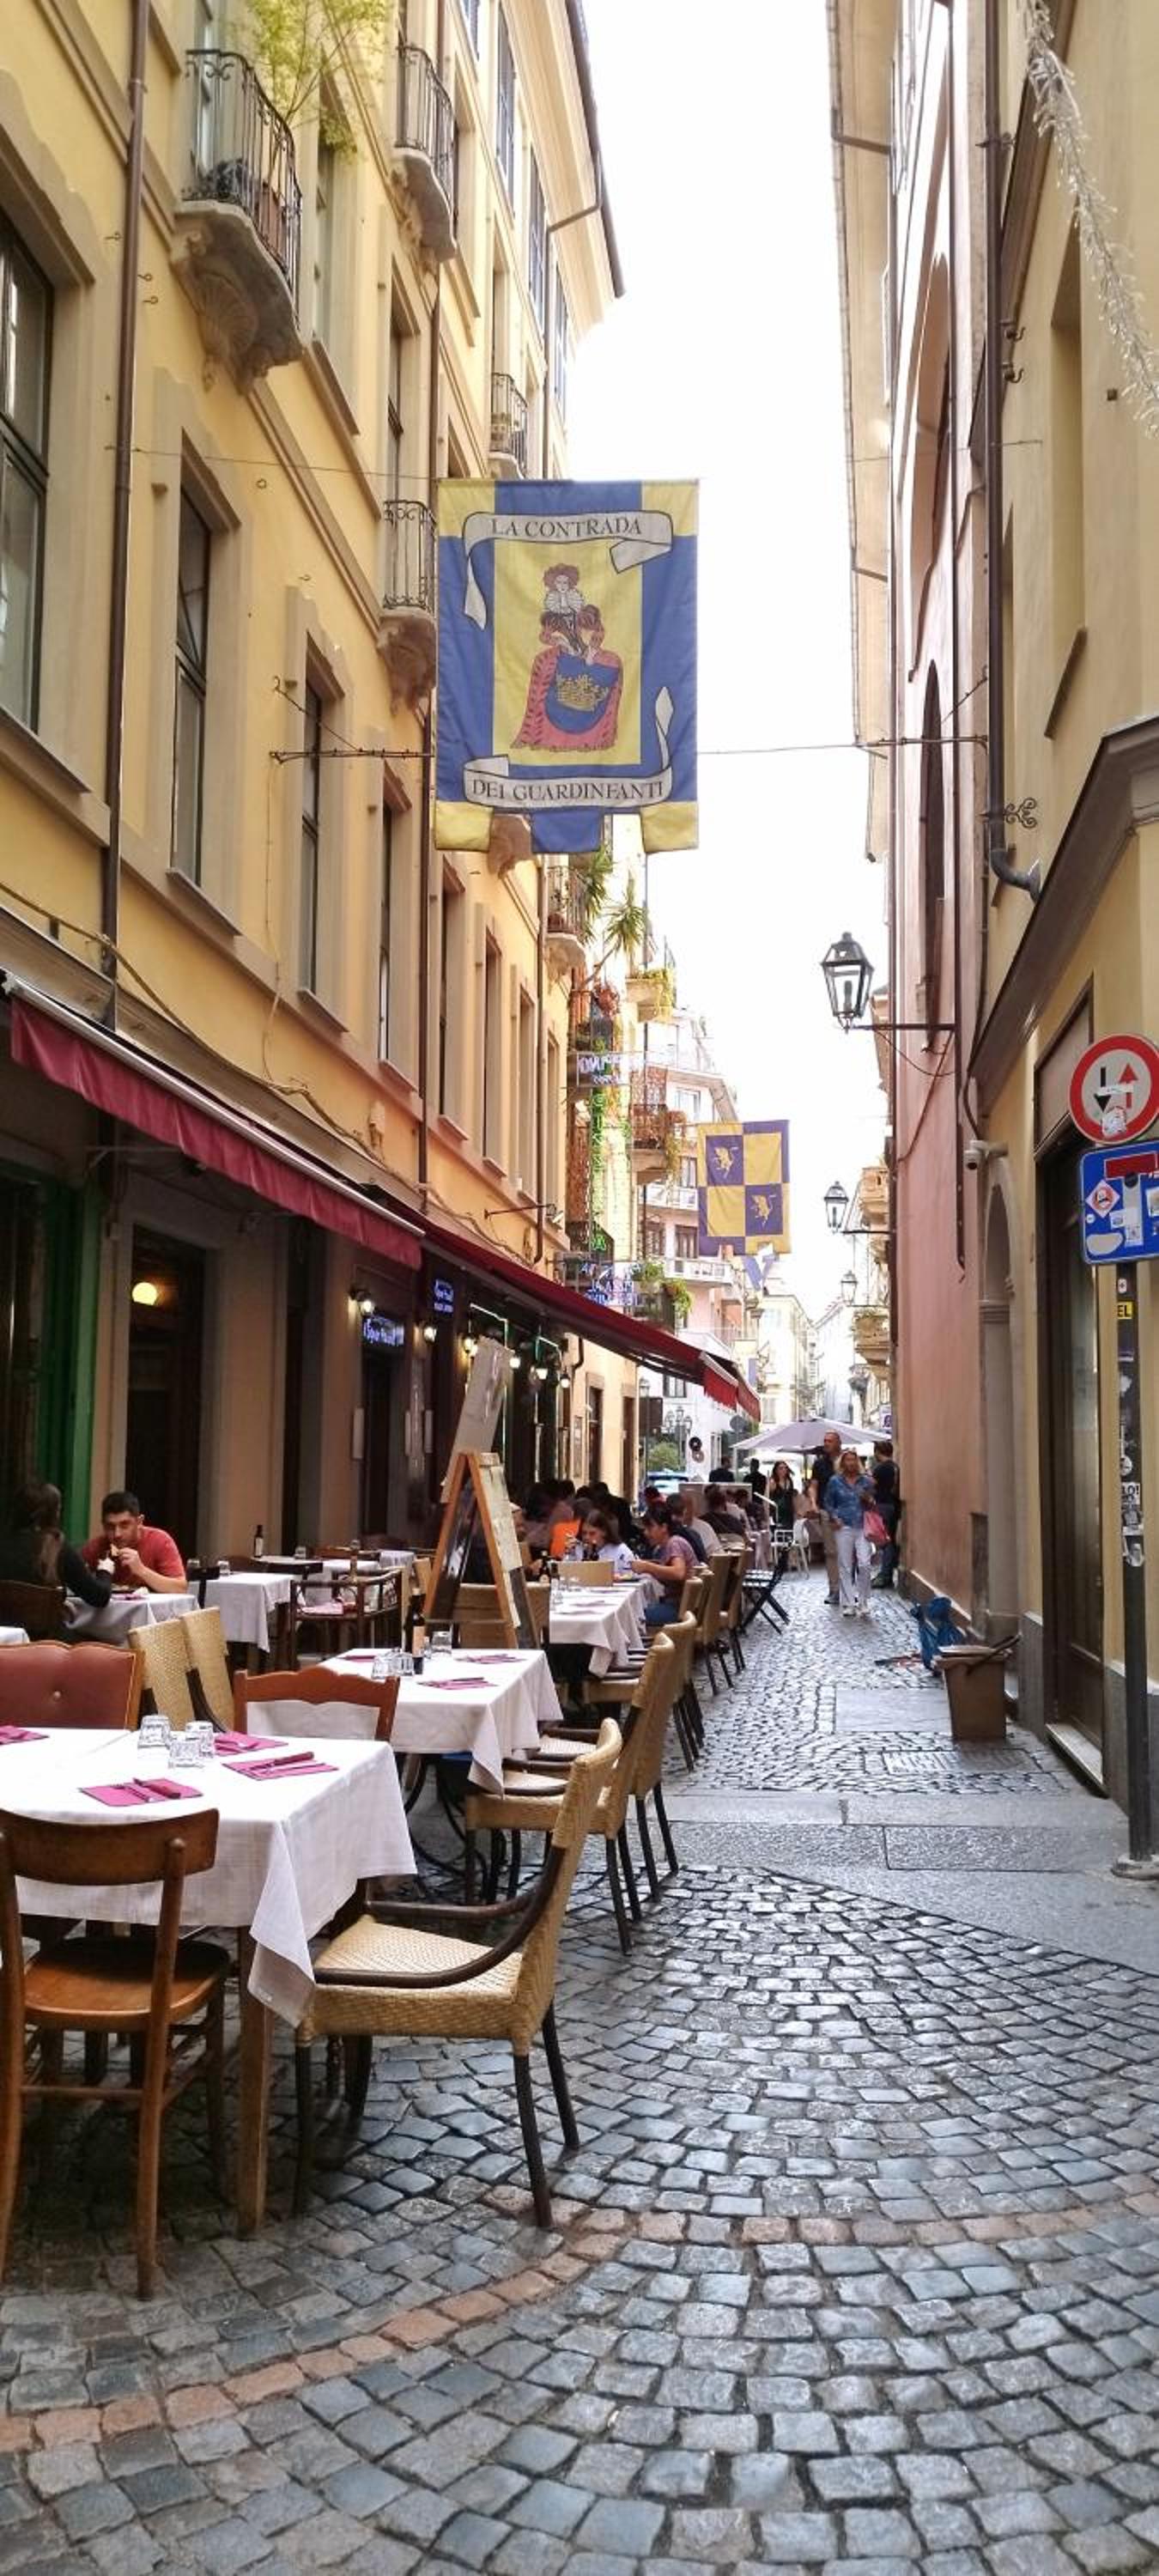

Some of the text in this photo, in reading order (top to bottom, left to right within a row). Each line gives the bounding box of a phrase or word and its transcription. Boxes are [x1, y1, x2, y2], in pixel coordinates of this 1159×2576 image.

[493, 516, 642, 537] LA CONTRADA
[472, 779, 664, 800] DEI GUARDINFANTI
